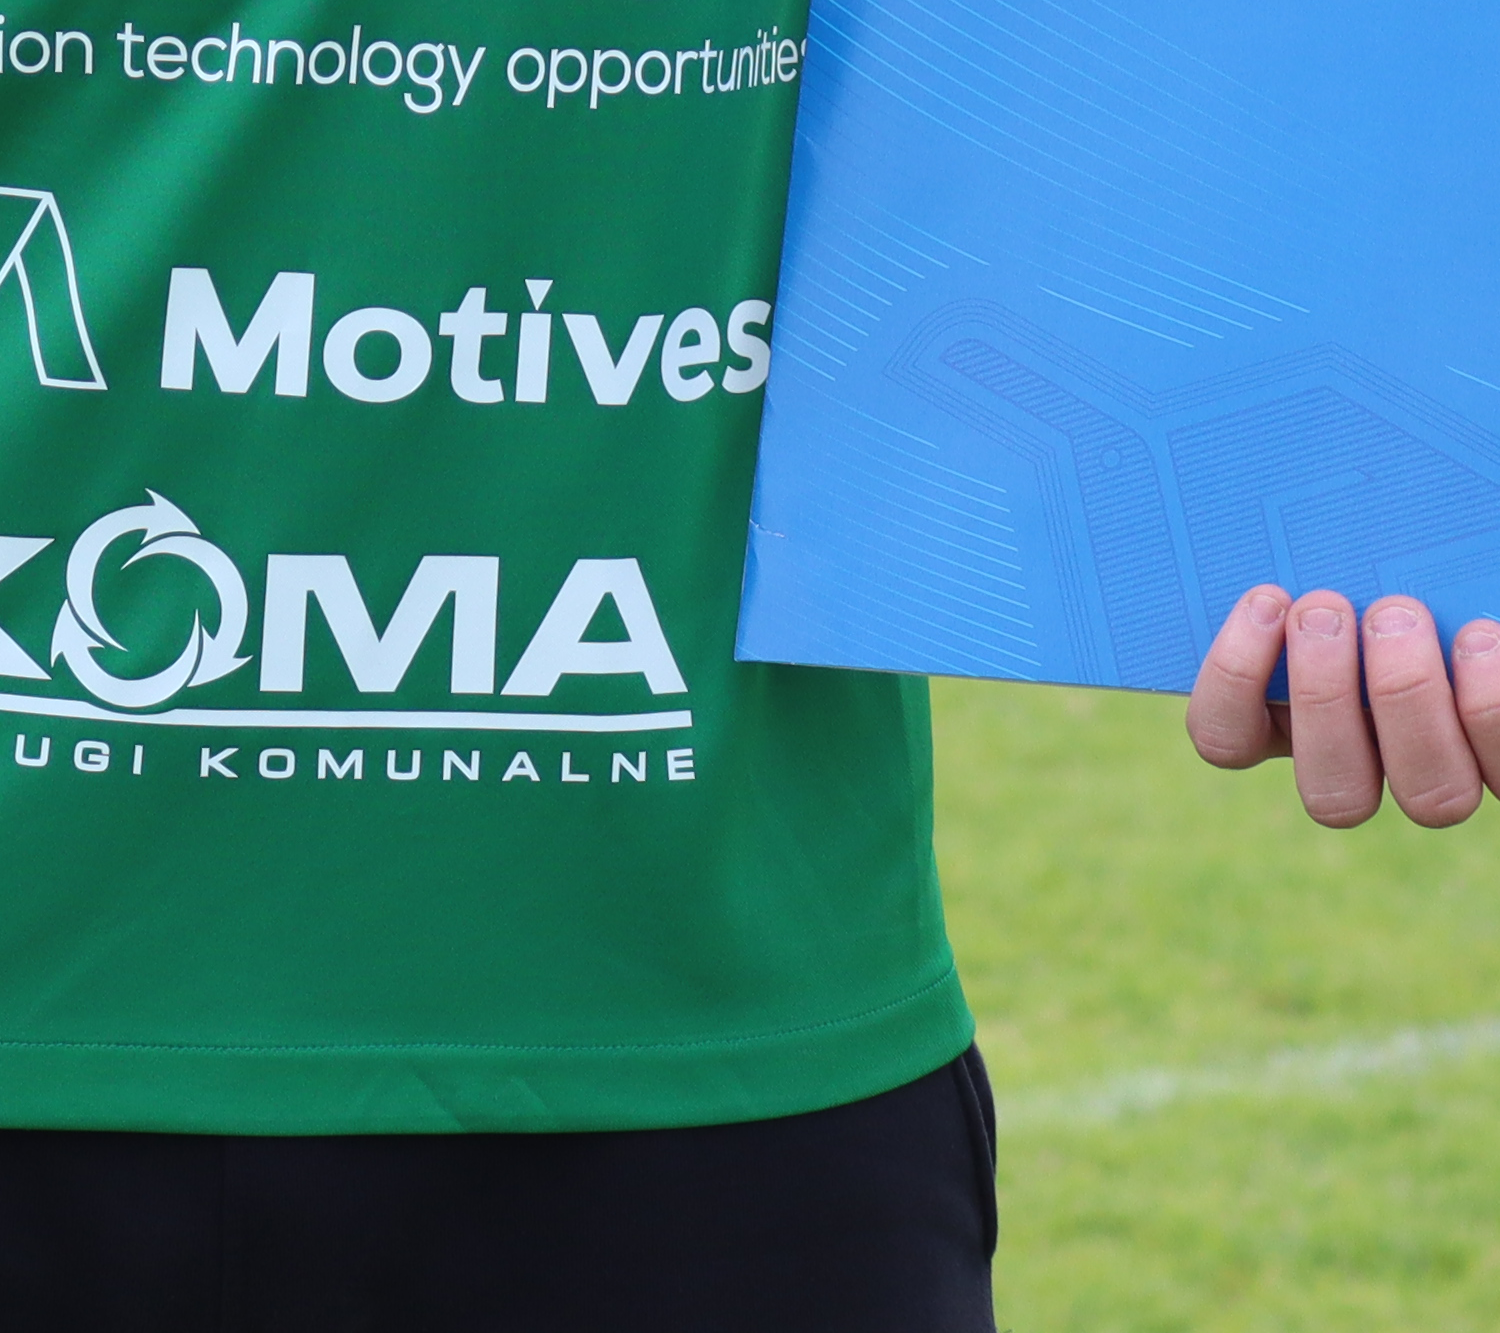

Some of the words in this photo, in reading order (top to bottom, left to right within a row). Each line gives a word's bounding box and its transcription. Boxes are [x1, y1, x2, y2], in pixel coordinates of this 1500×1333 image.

[116, 21, 486, 114] technology
[160, 267, 771, 407] Motives
[199, 746, 697, 783] KOMUNALNE
